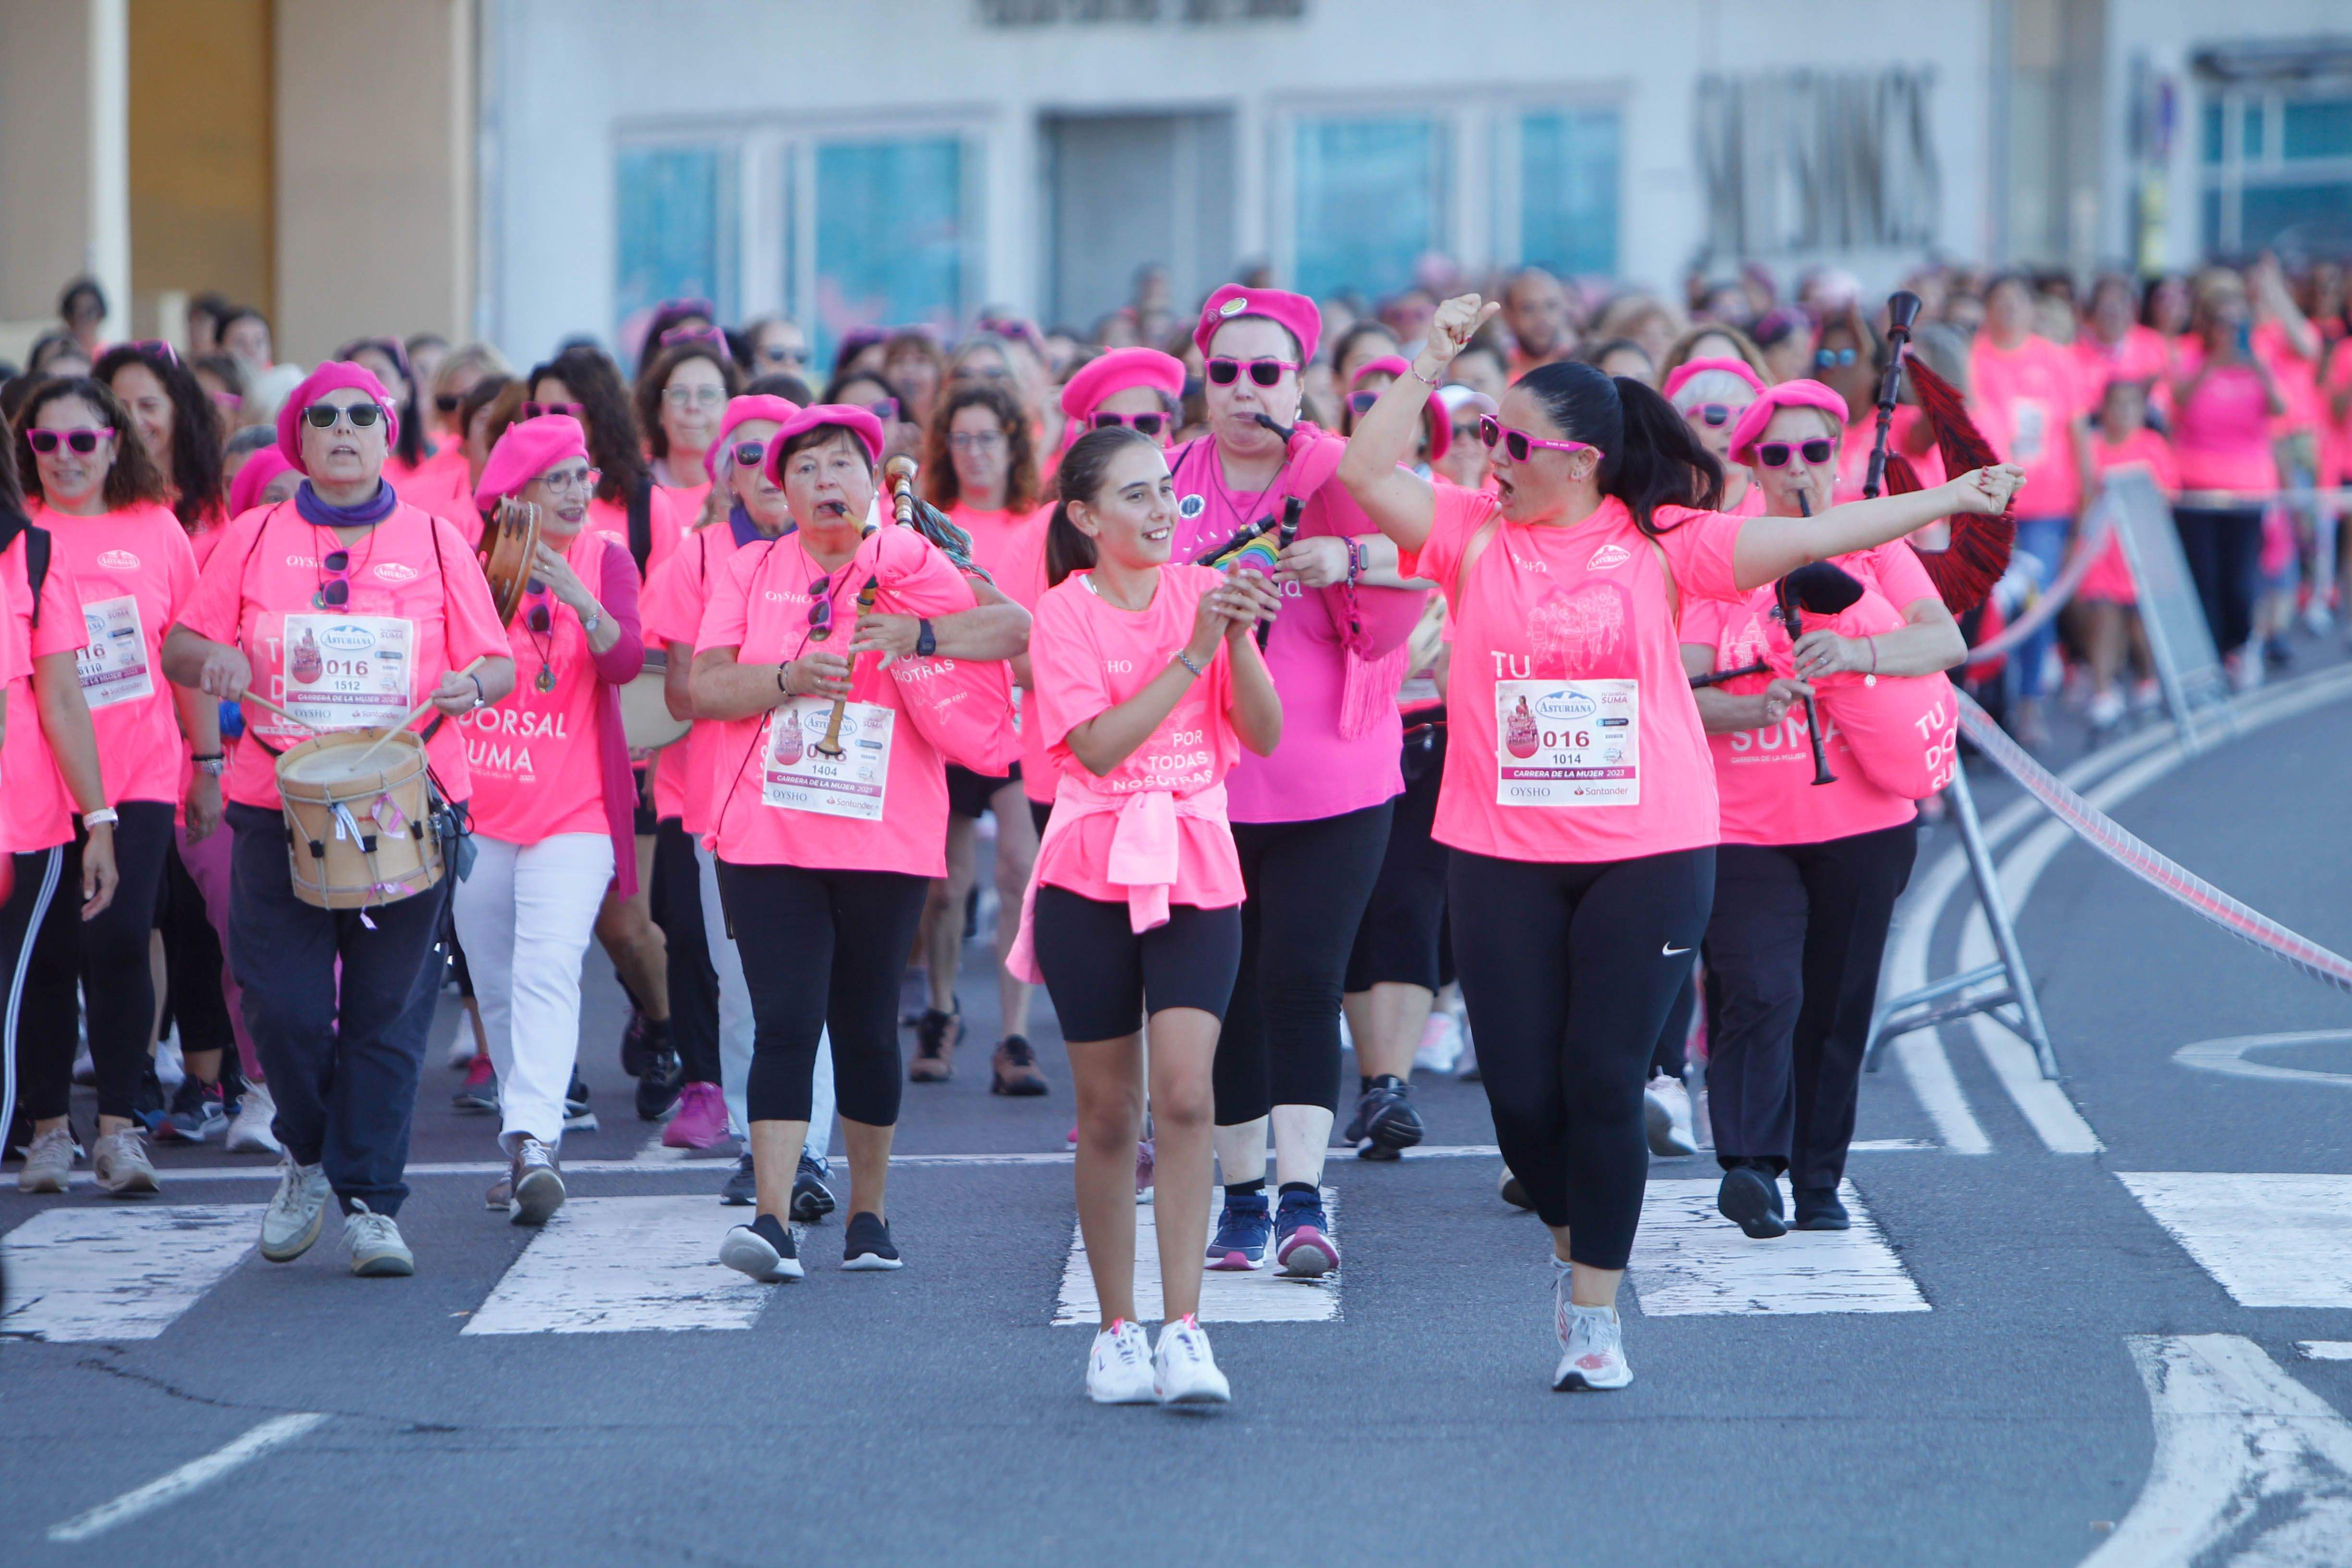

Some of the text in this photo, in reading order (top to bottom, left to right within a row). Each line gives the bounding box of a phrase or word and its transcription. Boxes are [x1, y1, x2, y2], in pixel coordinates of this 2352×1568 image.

[1591, 552, 1627, 567] ASTURIANA
[326, 634, 371, 645] ASTURIANA
[326, 659, 369, 675] 016
[1491, 650, 1531, 678] TU
[100, 672, 122, 682] MUJER
[110, 682, 142, 694] Santander
[335, 680, 360, 691] 1512
[951, 691, 968, 702] 2021
[1540, 701, 1592, 712] ASTURIANA
[295, 709, 331, 718] OYSHO
[362, 710, 400, 719] Santander
[862, 721, 883, 729] SUMA
[1915, 701, 1945, 740] TU
[1173, 730, 1203, 747] POR
[1543, 730, 1590, 747] 016
[468, 738, 534, 772] UMA
[1148, 751, 1208, 770] TODAS
[1553, 753, 1581, 764] 1014
[1782, 752, 1806, 760] MUJER
[812, 764, 837, 776] 1404
[777, 774, 808, 784] CARRERA
[831, 783, 855, 791] MUJER
[1113, 770, 1213, 791] NOSOTRAS
[772, 789, 807, 802] OYSHO
[1510, 786, 1550, 796] OYSHO
[1585, 786, 1629, 796] Santander
[836, 798, 873, 810] Santander
